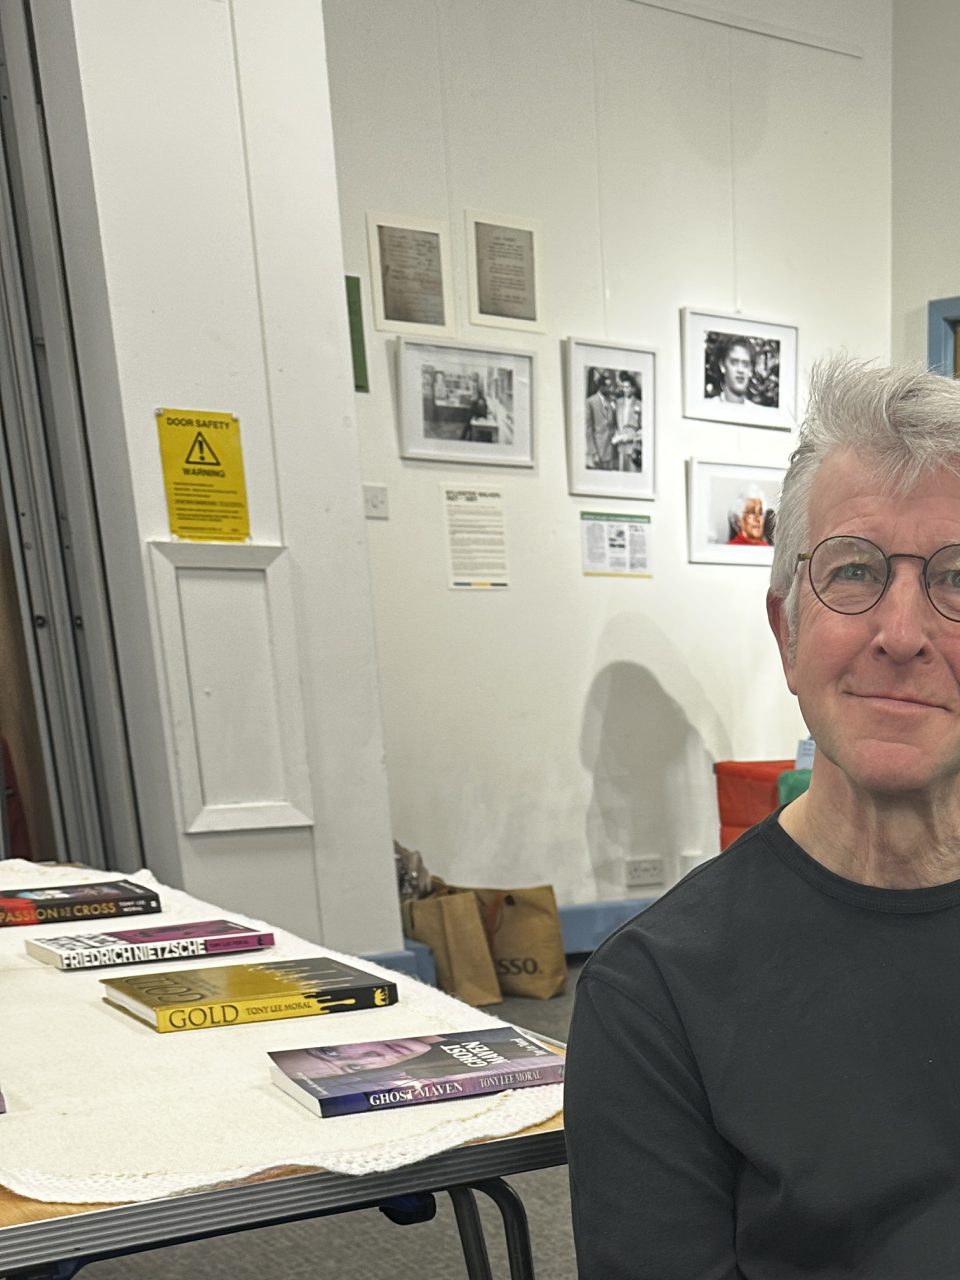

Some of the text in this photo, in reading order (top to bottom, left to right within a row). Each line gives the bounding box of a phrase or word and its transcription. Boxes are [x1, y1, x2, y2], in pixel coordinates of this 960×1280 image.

[167, 417, 230, 429] DOOR SAFETY
[183, 468, 226, 478] WARNING
[0, 907, 58, 922] PASSION
[73, 902, 116, 916] CROSS
[63, 948, 135, 967] FRIEDRICH
[136, 939, 206, 960] NIETZSCHE
[169, 1001, 312, 1028] GOLD TONY LEE MORAL
[441, 1045, 488, 1067] GHOST
[461, 1040, 511, 1065] MAVEN
[370, 1070, 542, 1106] GHOST MAVEN TONY LEE MORAL
